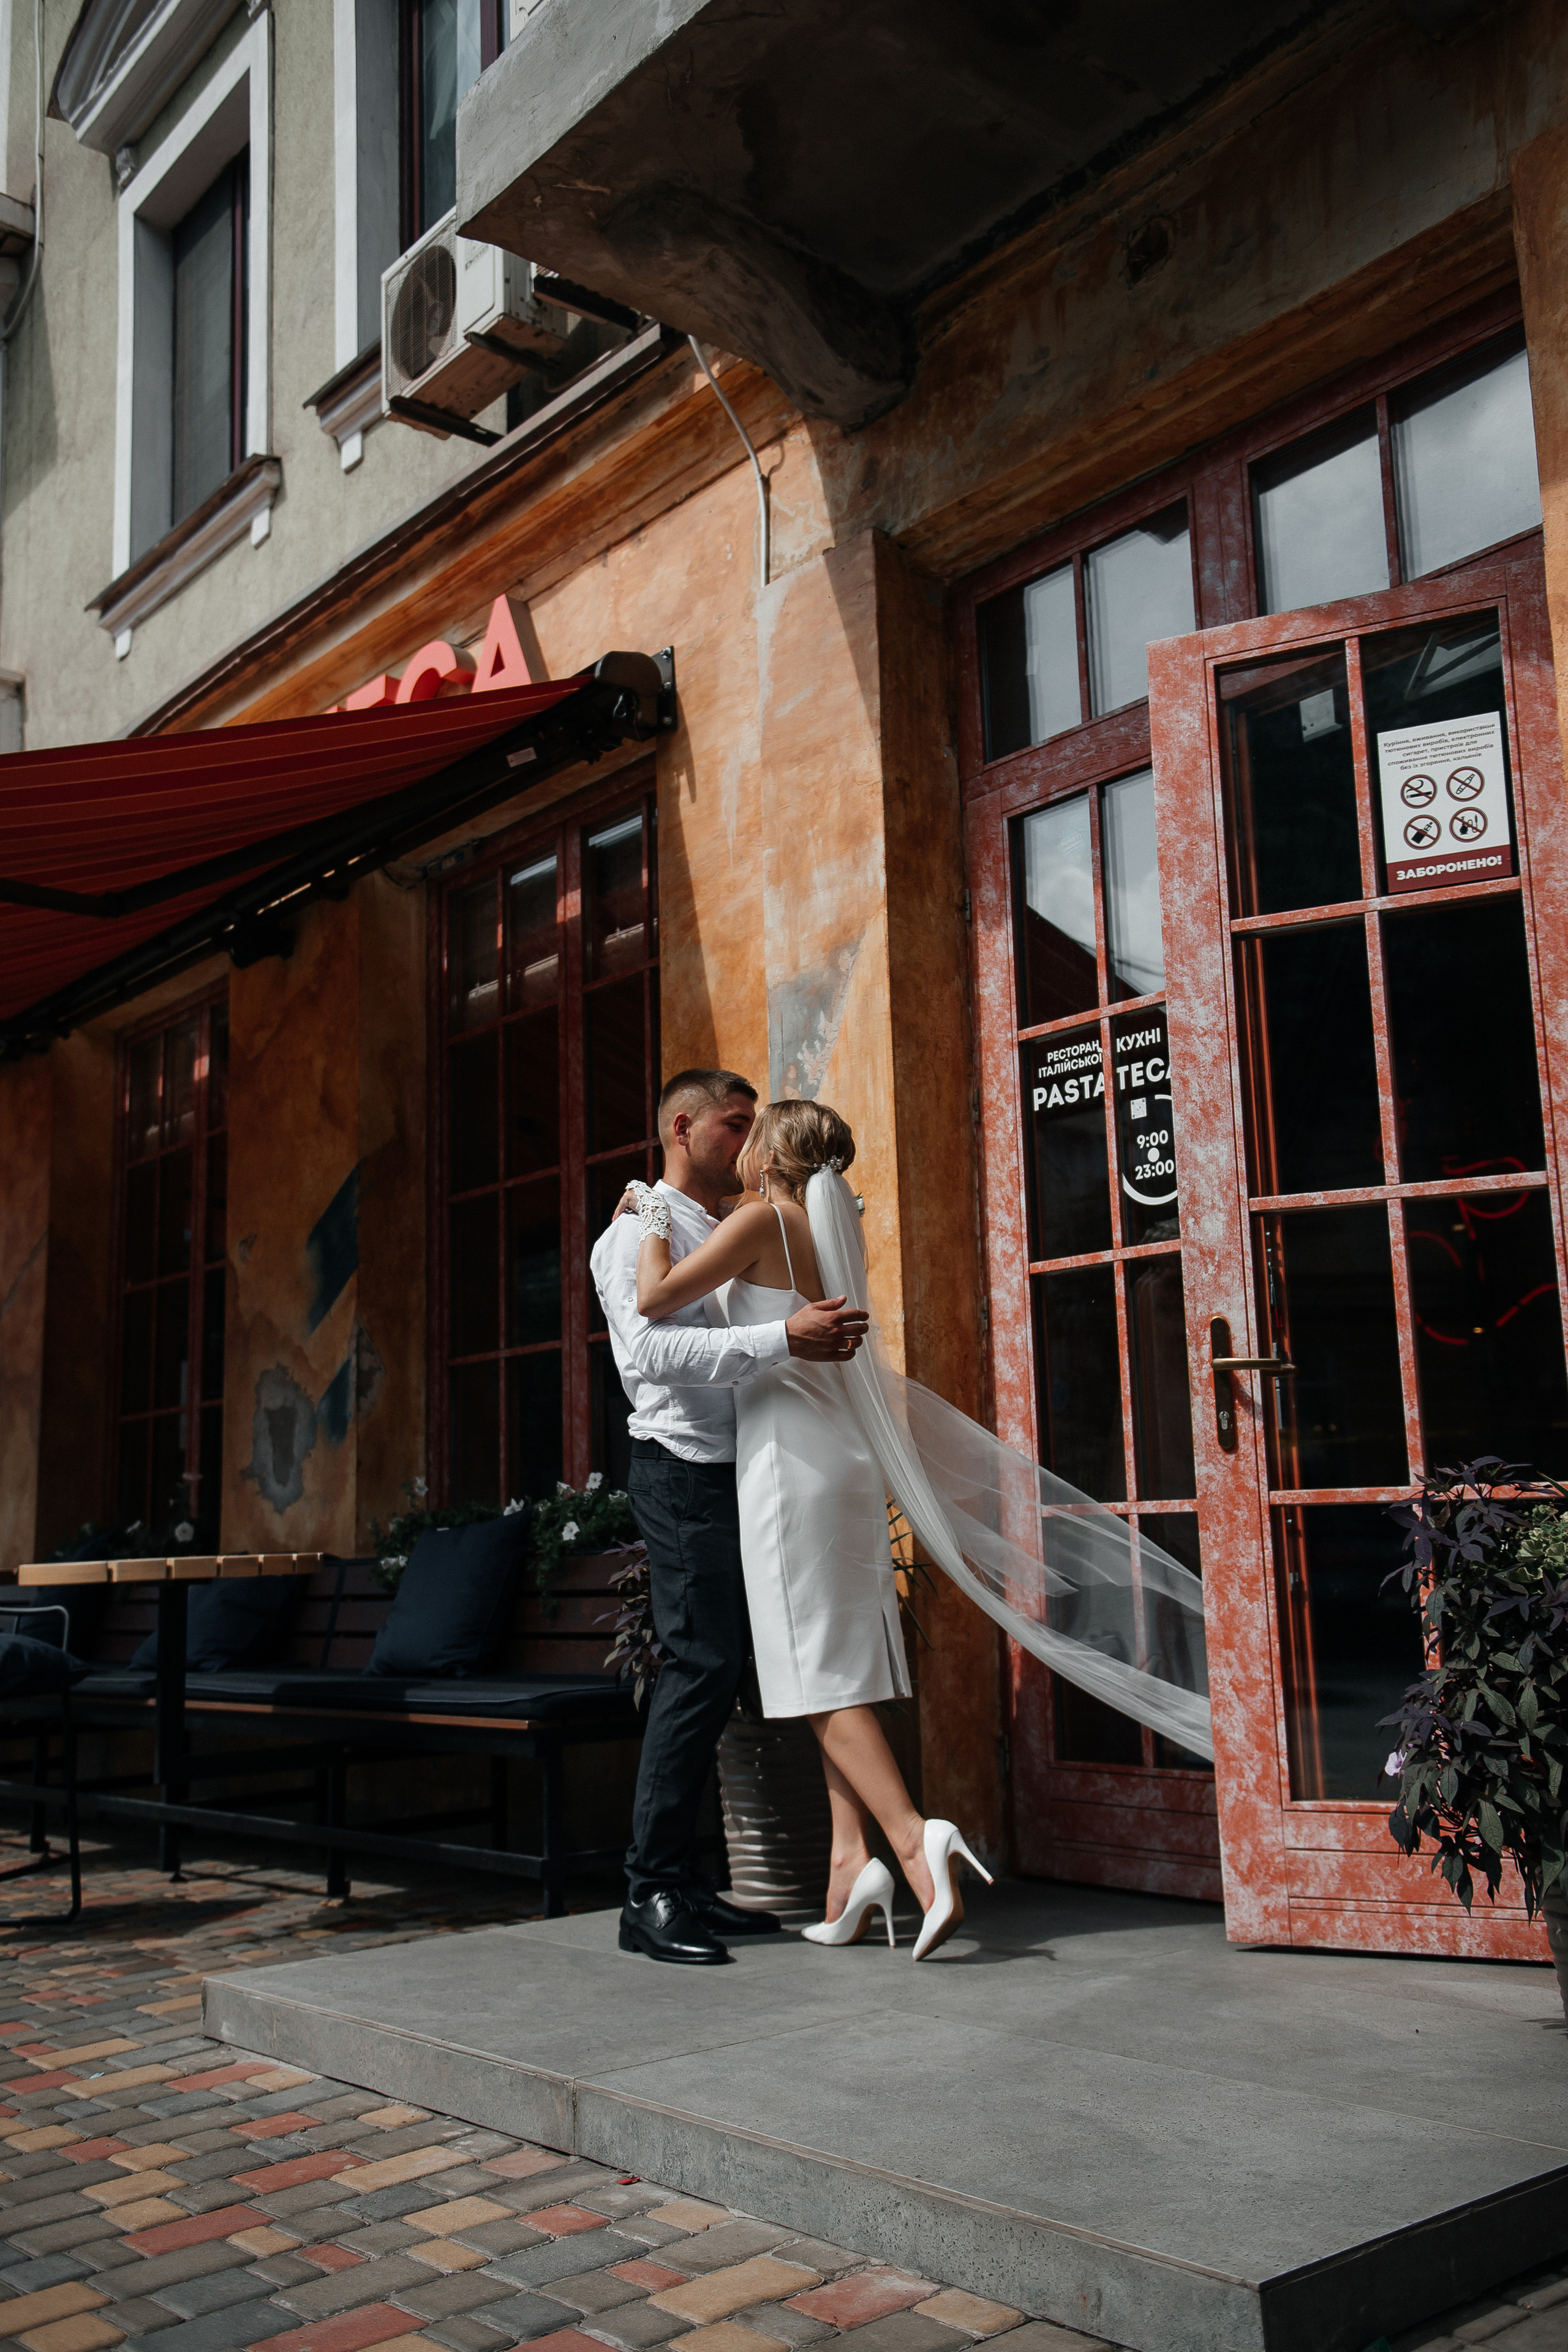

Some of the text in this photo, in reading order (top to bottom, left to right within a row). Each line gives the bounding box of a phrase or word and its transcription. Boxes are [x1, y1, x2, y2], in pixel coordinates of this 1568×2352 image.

[1384, 723, 1495, 748] Куріння, вживання, використання
[1385, 730, 1495, 753] тютюнових виробів, електронних
[1387, 743, 1494, 766] споживання тютюнових виробів
[1403, 748, 1430, 757] сигарет,
[1431, 742, 1464, 753] пристроїв
[1453, 752, 1482, 761] кальянів
[1396, 855, 1502, 881] ЗАБОРОНЕНО!
[1116, 1027, 1161, 1053] КУХНІ
[1137, 1129, 1168, 1149] 9:00
[1135, 1159, 1174, 1180] 23:00
